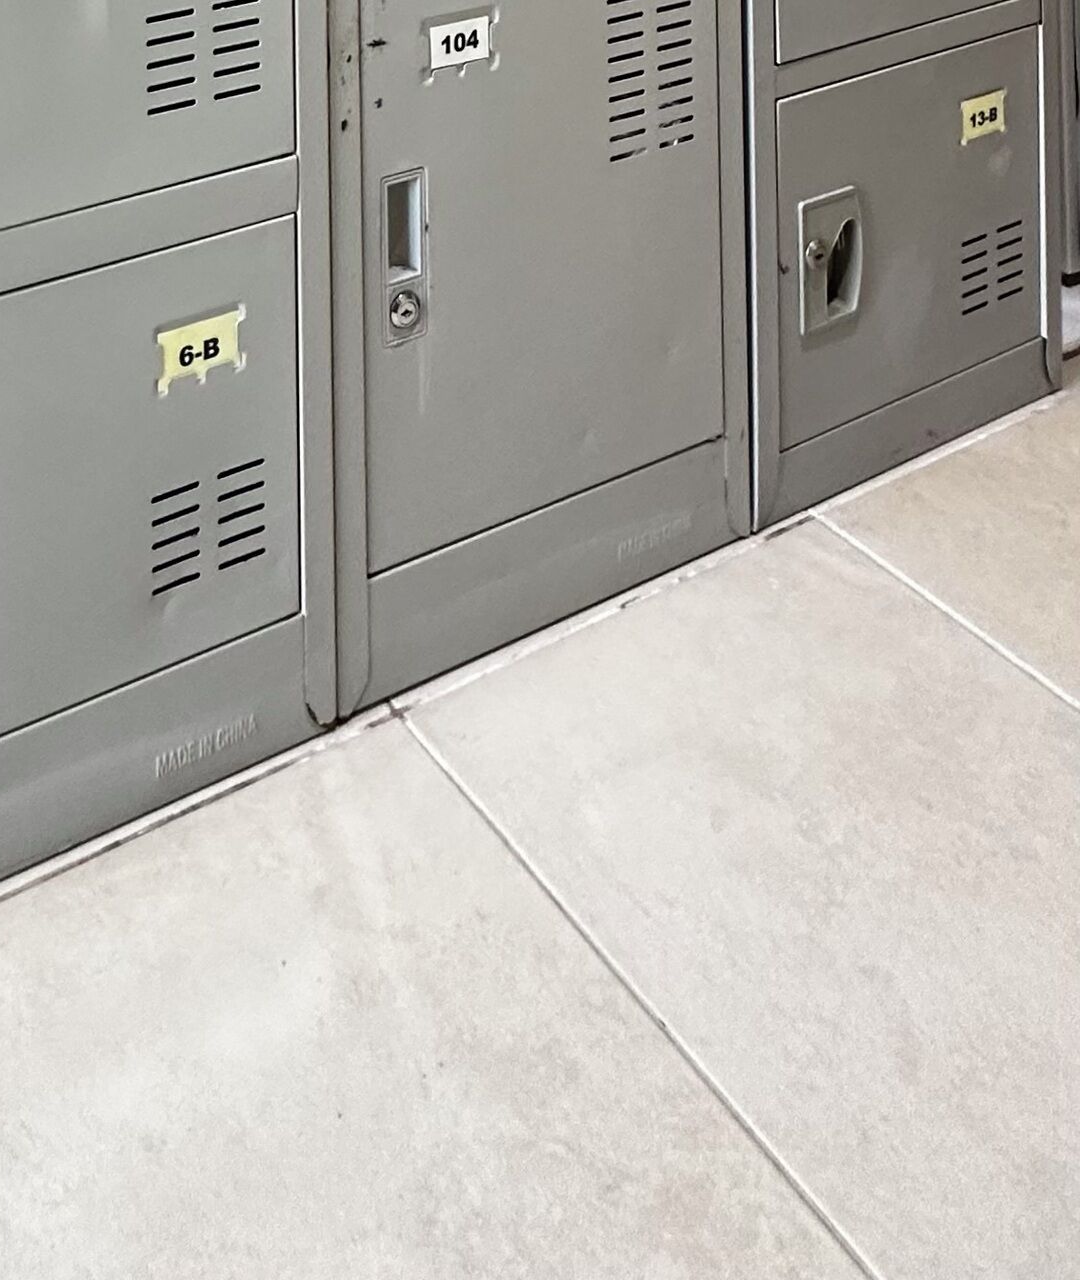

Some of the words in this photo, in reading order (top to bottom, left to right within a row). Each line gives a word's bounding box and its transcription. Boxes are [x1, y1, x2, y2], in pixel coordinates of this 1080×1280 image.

[441, 28, 480, 55] 104
[969, 106, 998, 128] 13-B
[178, 337, 220, 367] 6-B
[155, 740, 196, 778] MADE
[199, 733, 215, 759] IN
[216, 713, 258, 751] CHINA
